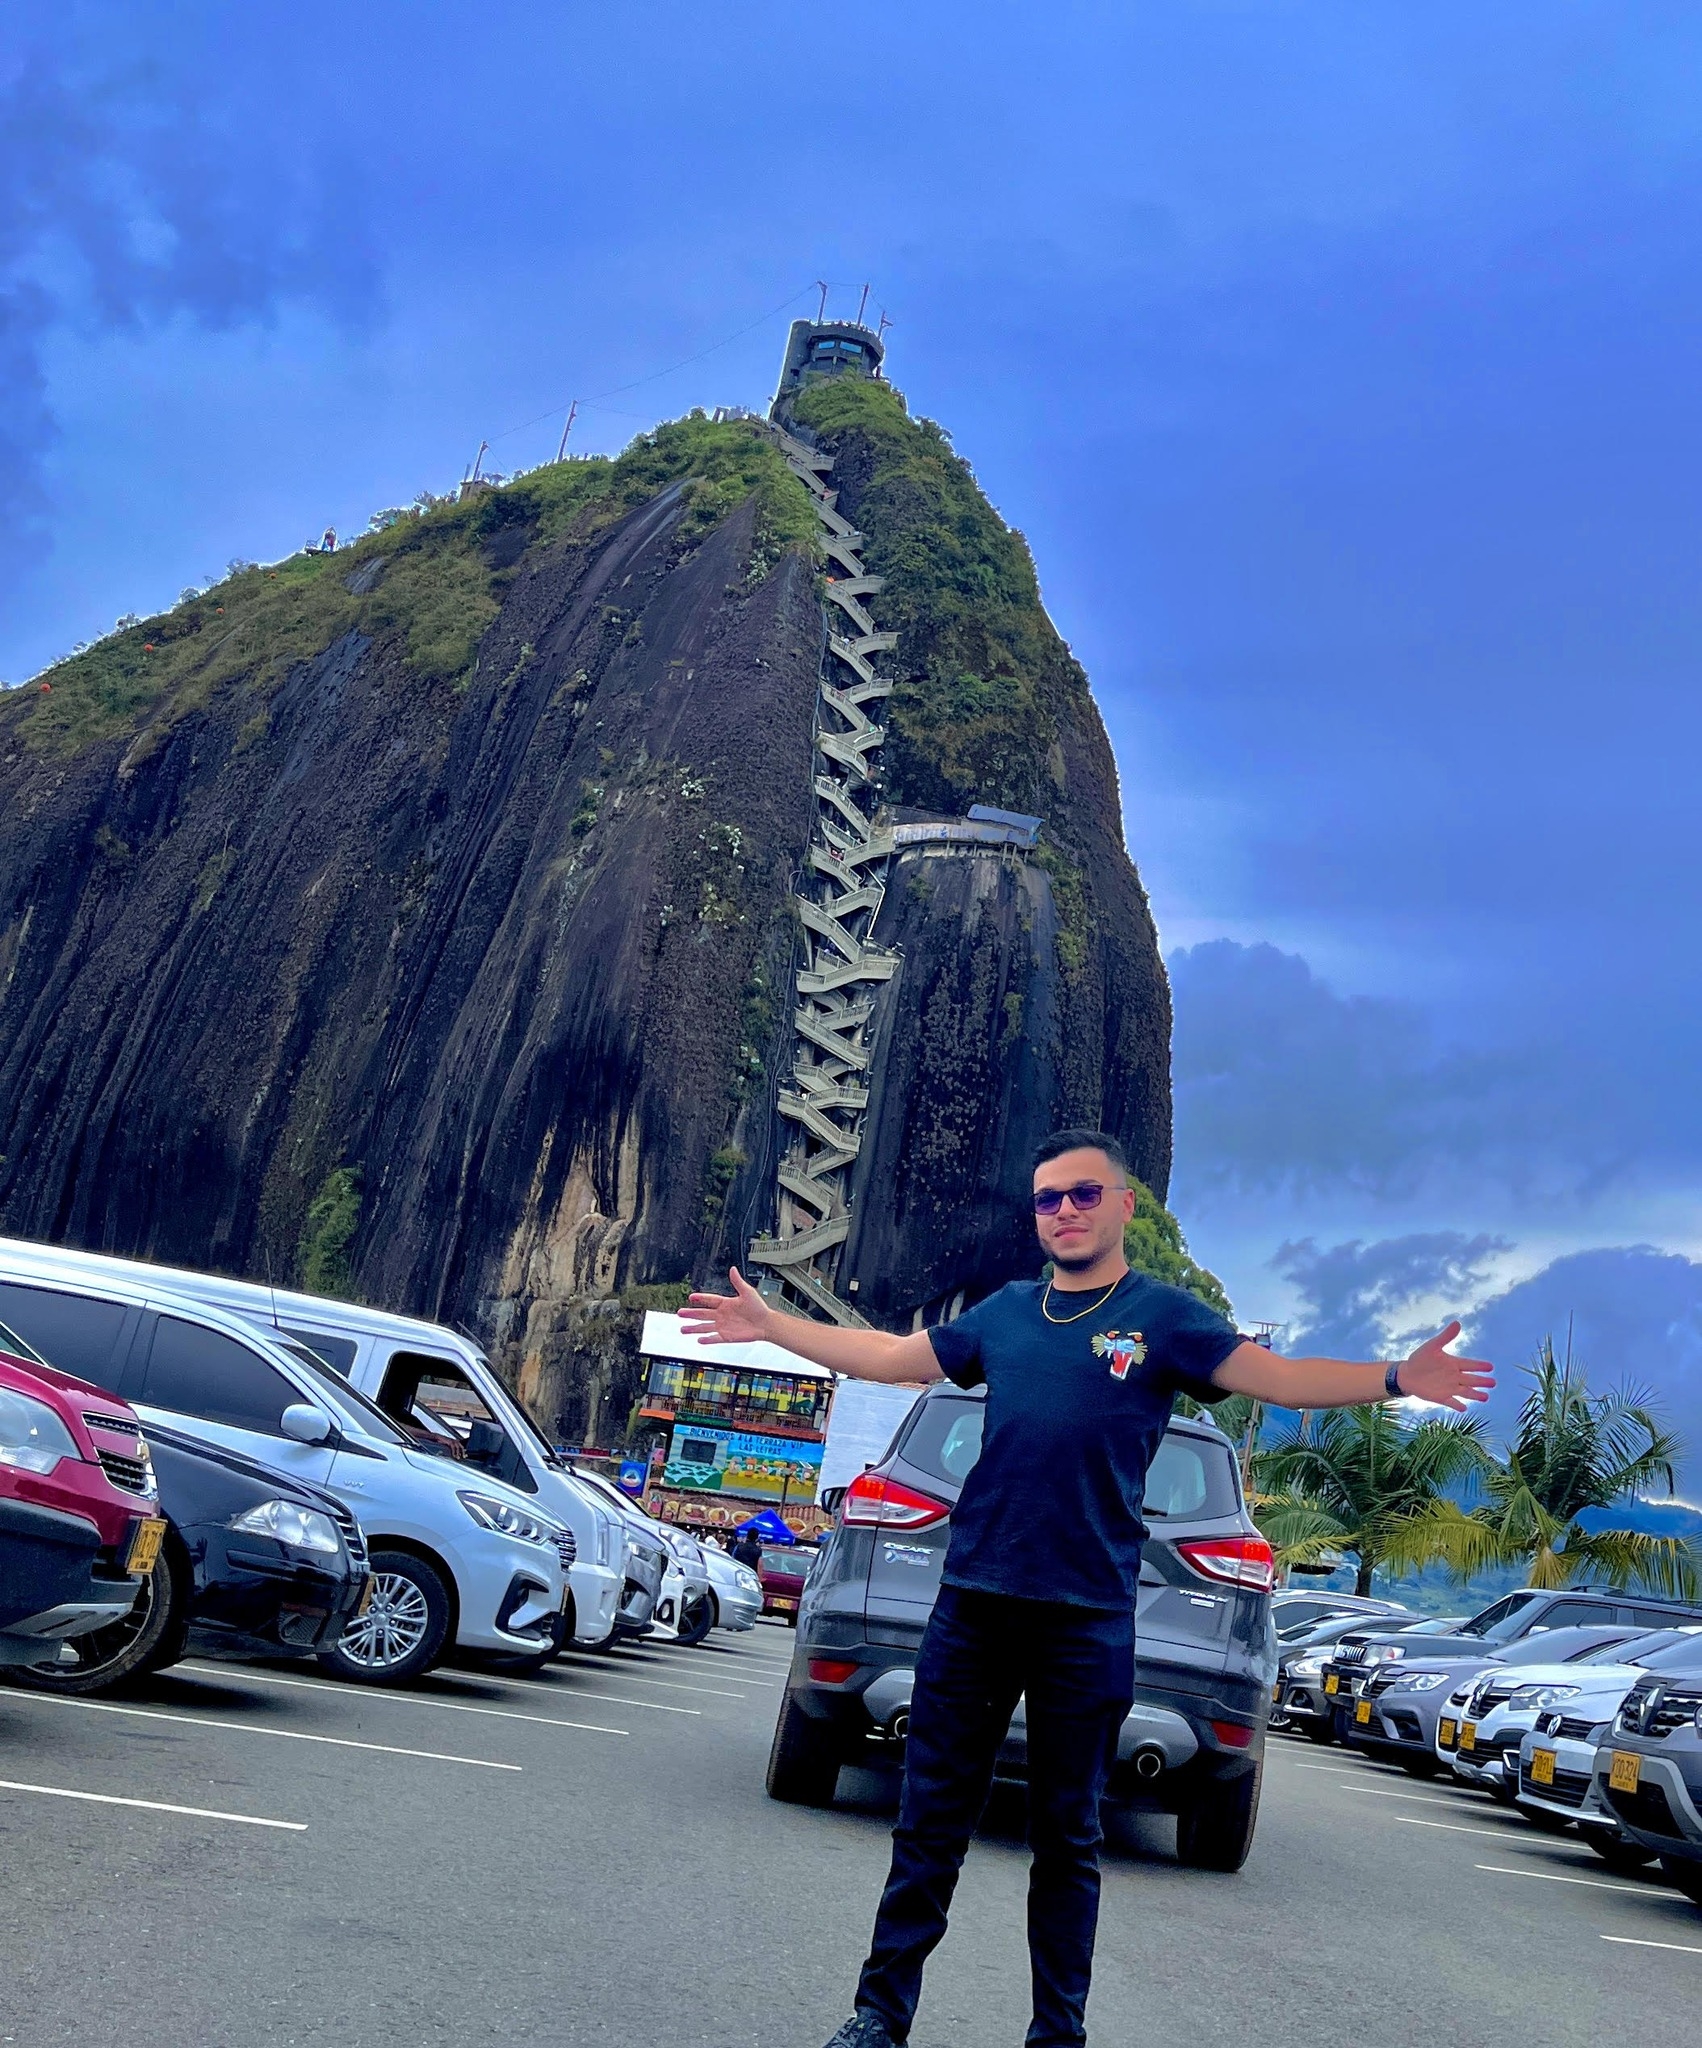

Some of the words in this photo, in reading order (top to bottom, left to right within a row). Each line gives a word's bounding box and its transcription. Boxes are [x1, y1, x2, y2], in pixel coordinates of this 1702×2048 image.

[690, 1427, 735, 1440] BIENVENIDOS
[744, 1435, 753, 1443] LA
[755, 1436, 787, 1447] TERRAZA
[790, 1441, 805, 1449] VIP
[738, 1443, 753, 1451] LAS
[755, 1445, 782, 1455] LETRAS
